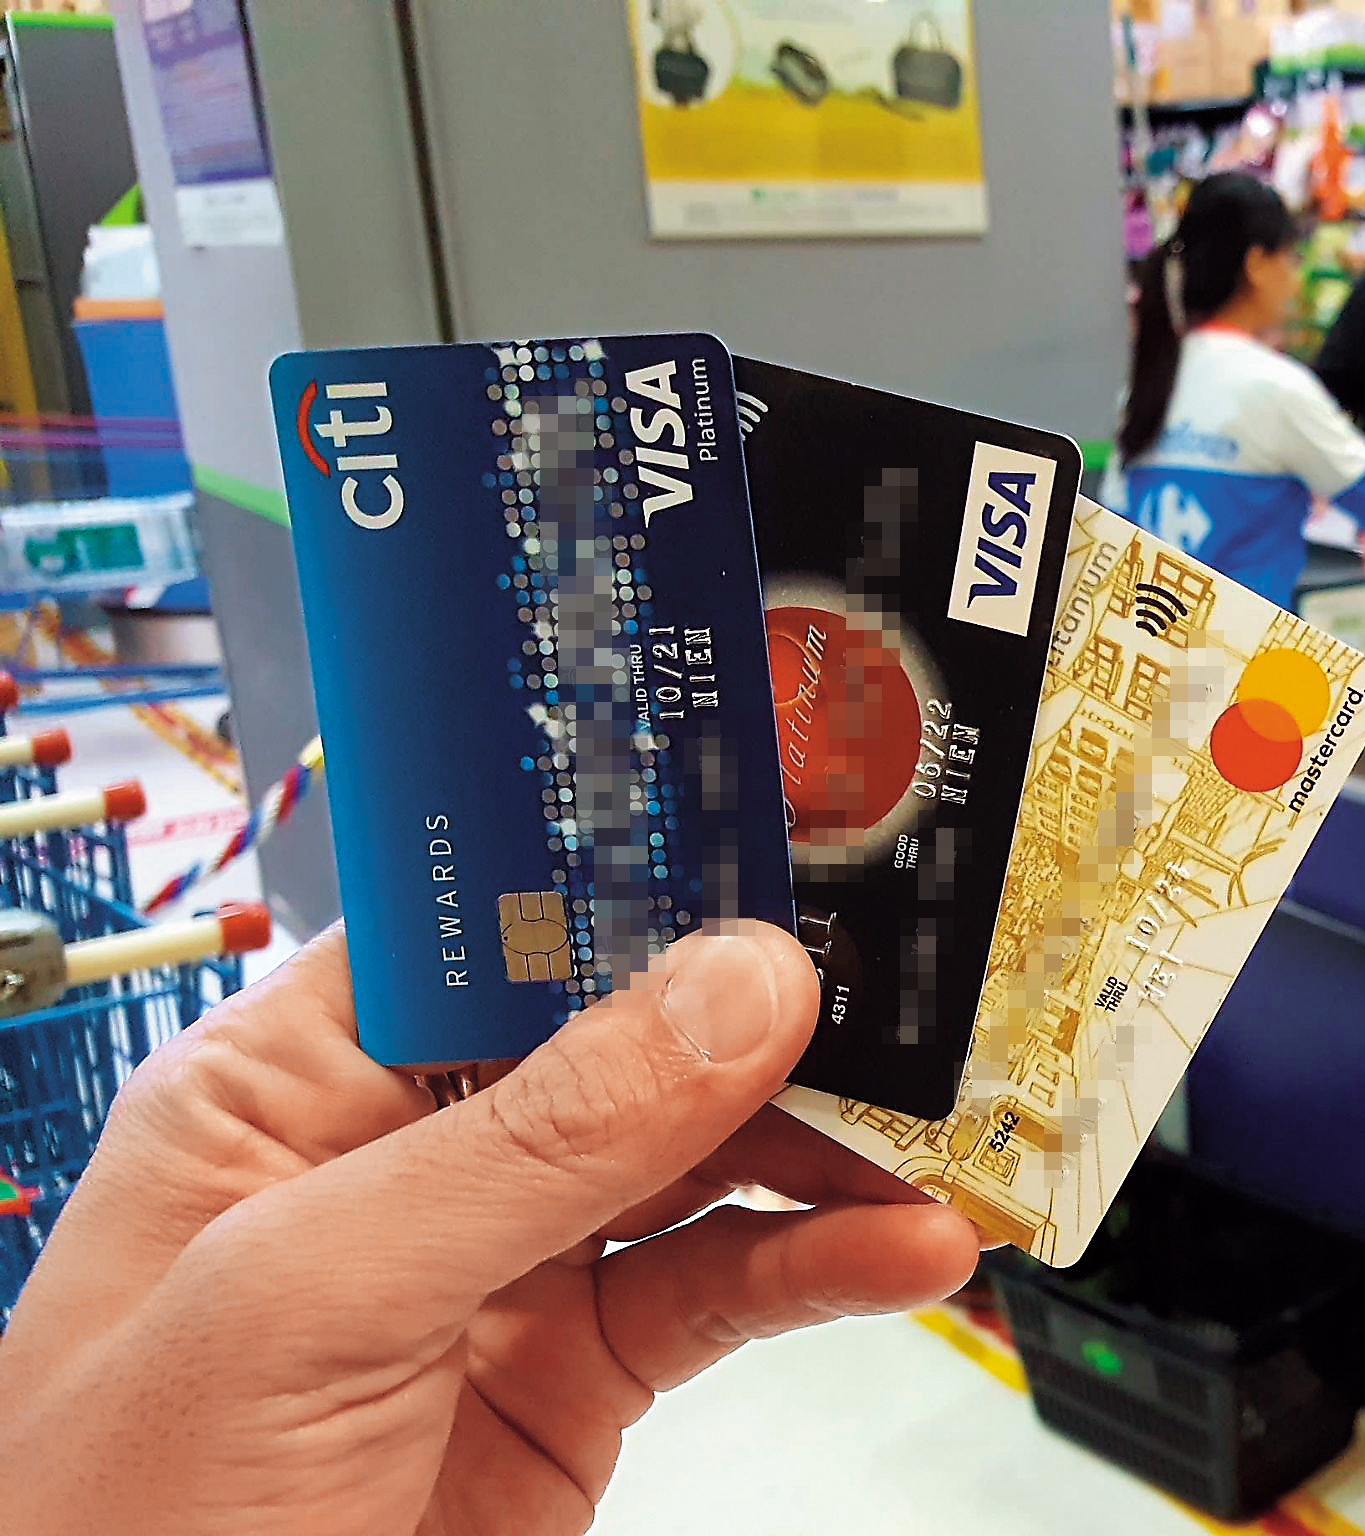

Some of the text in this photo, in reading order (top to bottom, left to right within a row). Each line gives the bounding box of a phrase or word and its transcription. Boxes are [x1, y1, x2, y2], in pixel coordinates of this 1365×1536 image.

[625, 359, 694, 528] VISA
[697, 356, 720, 462] Platinum
[967, 471, 1036, 609] VISA
[630, 644, 651, 730] VALID THRU
[648, 625, 685, 720] 10/21
[683, 627, 719, 708] NIEN
[914, 698, 953, 799] 06/22
[941, 723, 980, 805] NIEN
[894, 833, 909, 869] GOOD
[906, 838, 919, 870] THRU
[425, 814, 469, 987] REWARDS
[831, 984, 851, 1025] 4311
[1094, 976, 1119, 1009] VALID
[1105, 982, 1129, 1014] THRU
[988, 1111, 1021, 1153] 5242
